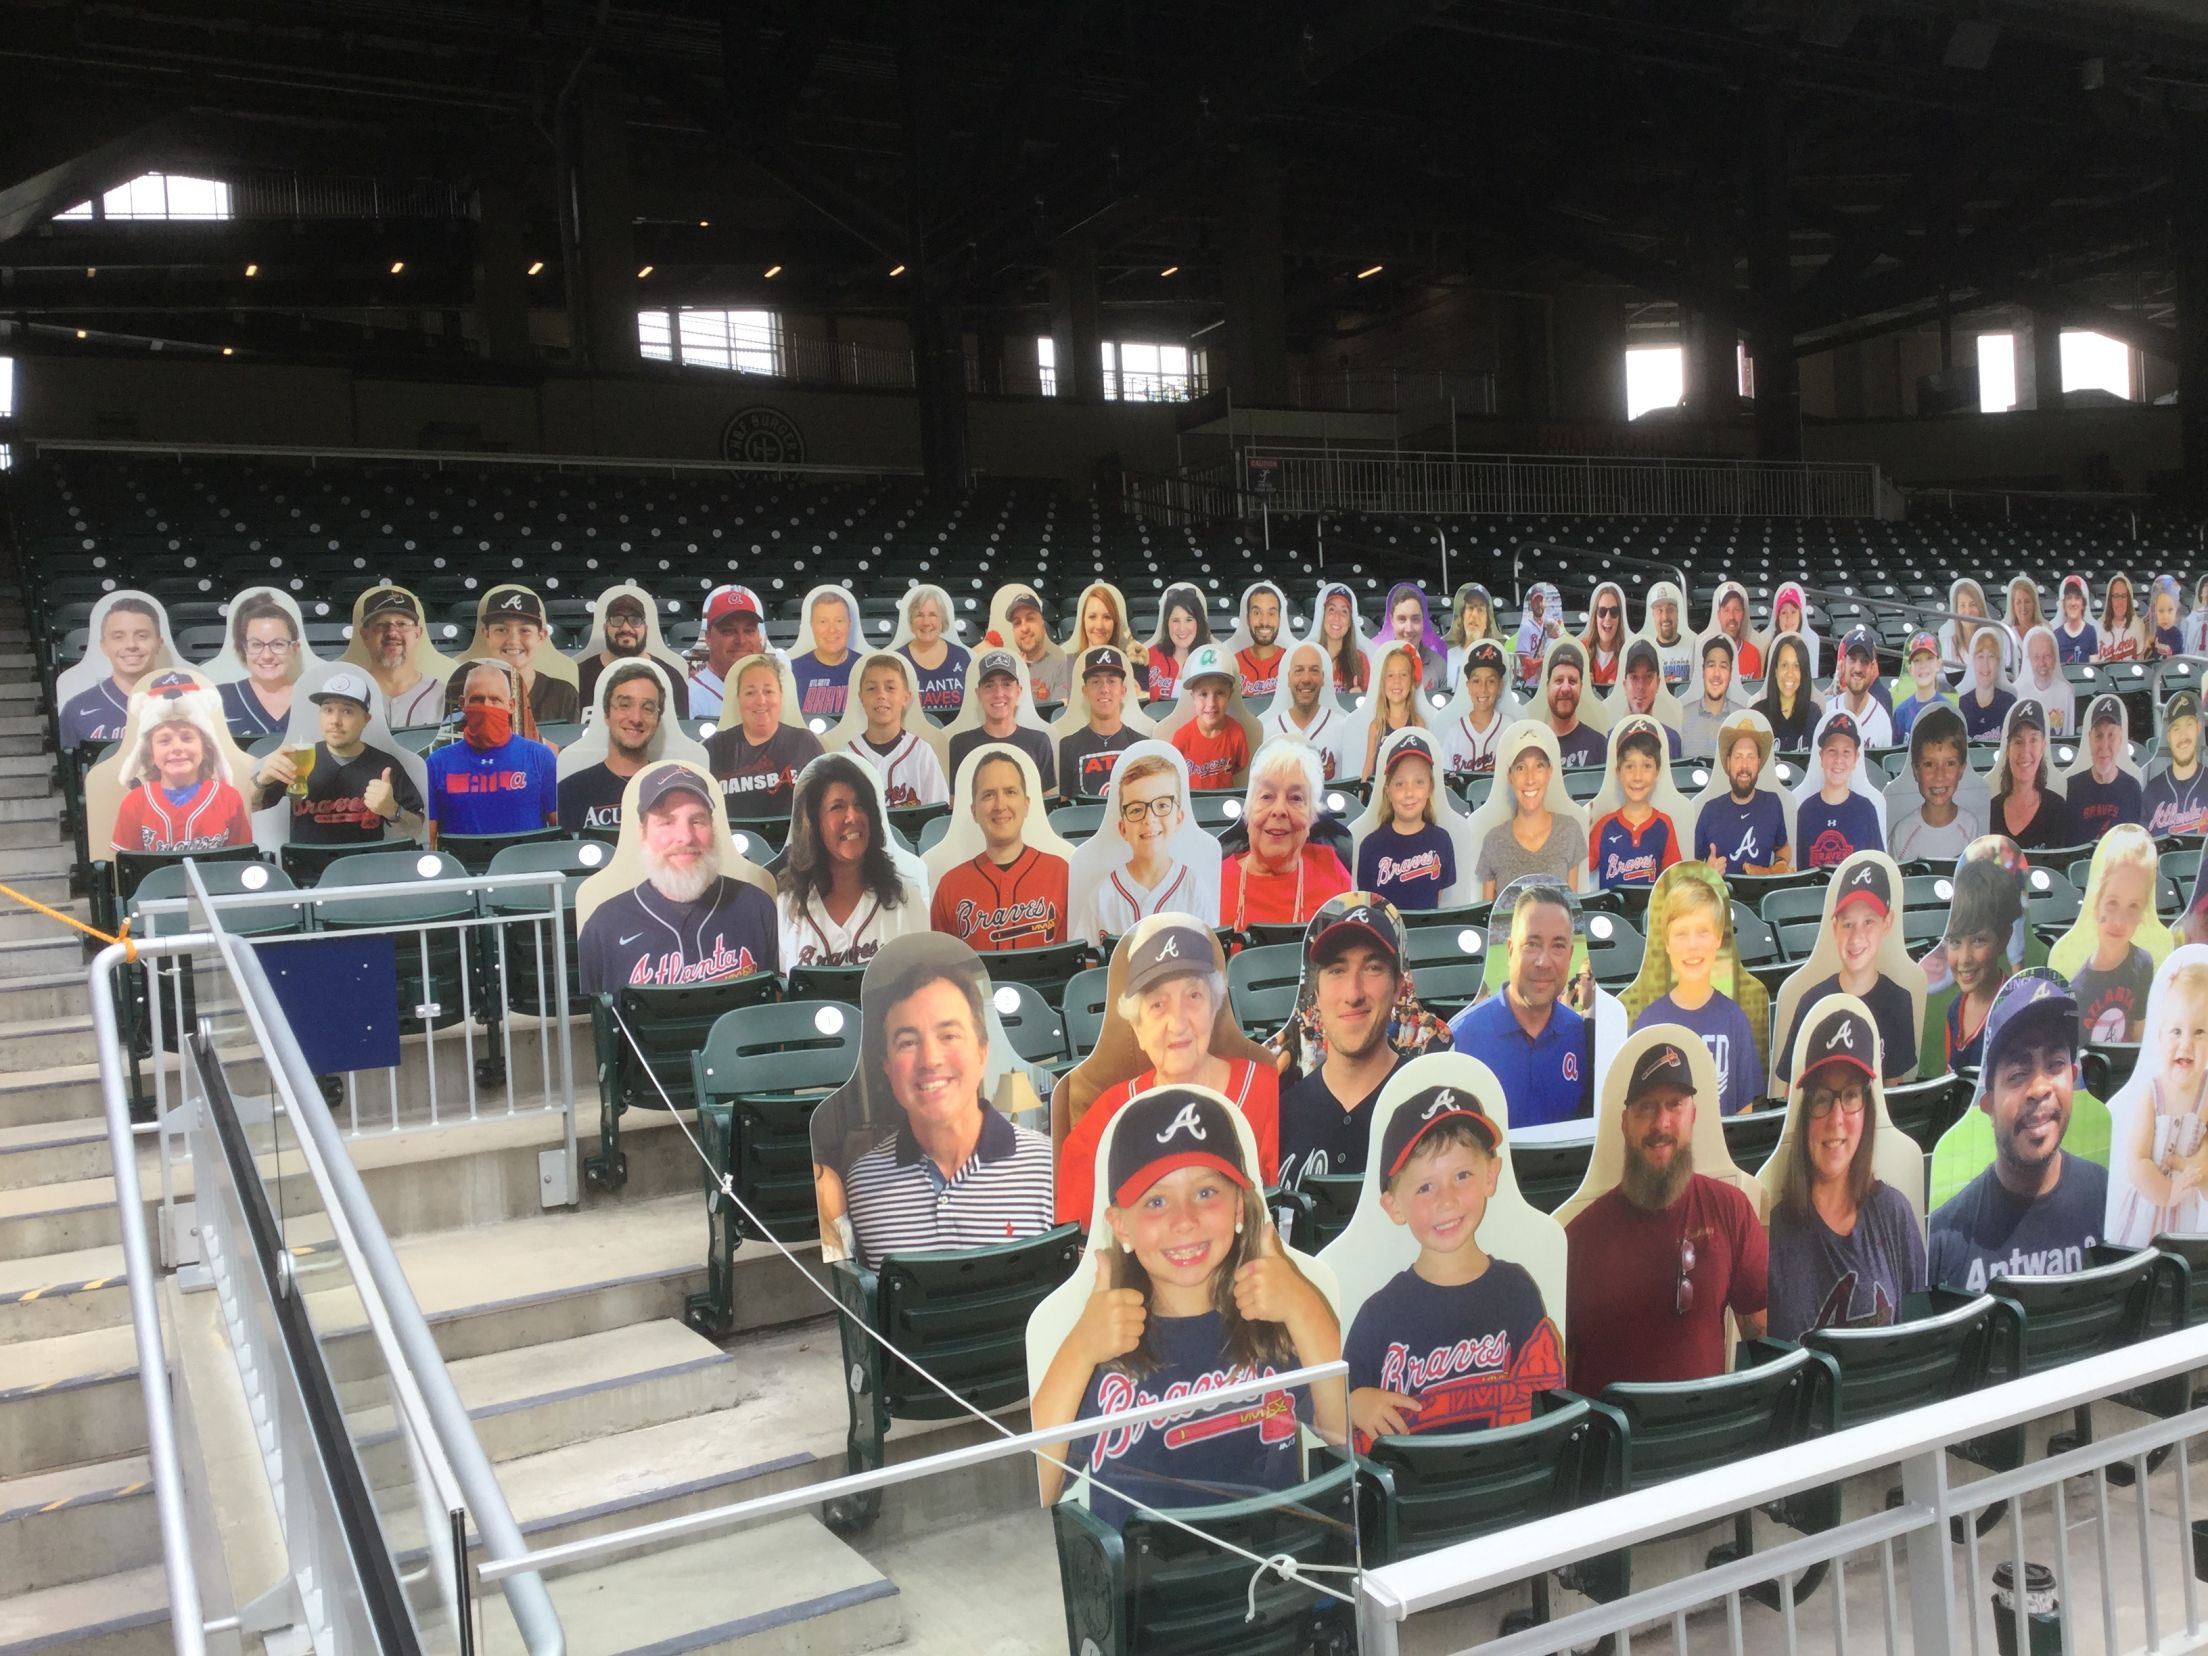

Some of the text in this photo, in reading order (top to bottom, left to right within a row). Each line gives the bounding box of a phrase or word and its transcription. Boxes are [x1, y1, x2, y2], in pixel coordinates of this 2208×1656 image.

[752, 414, 798, 451] BURGER
[802, 684, 850, 714] BRAV
[1729, 825, 1760, 862] A
[1376, 850, 1434, 888] Braves
[1606, 852, 1654, 880] Braves
[1851, 866, 1872, 885] A
[956, 896, 1046, 940] Braves
[629, 932, 739, 985] Atlanta
[1152, 934, 1180, 962] A
[1825, 1019, 1854, 1050] A
[1421, 1088, 1463, 1120] A
[1156, 1102, 1207, 1145] A
[1965, 1245, 2083, 1294] Antwan
[1380, 1329, 1508, 1397] Braves
[1091, 1360, 1259, 1473] Braves
